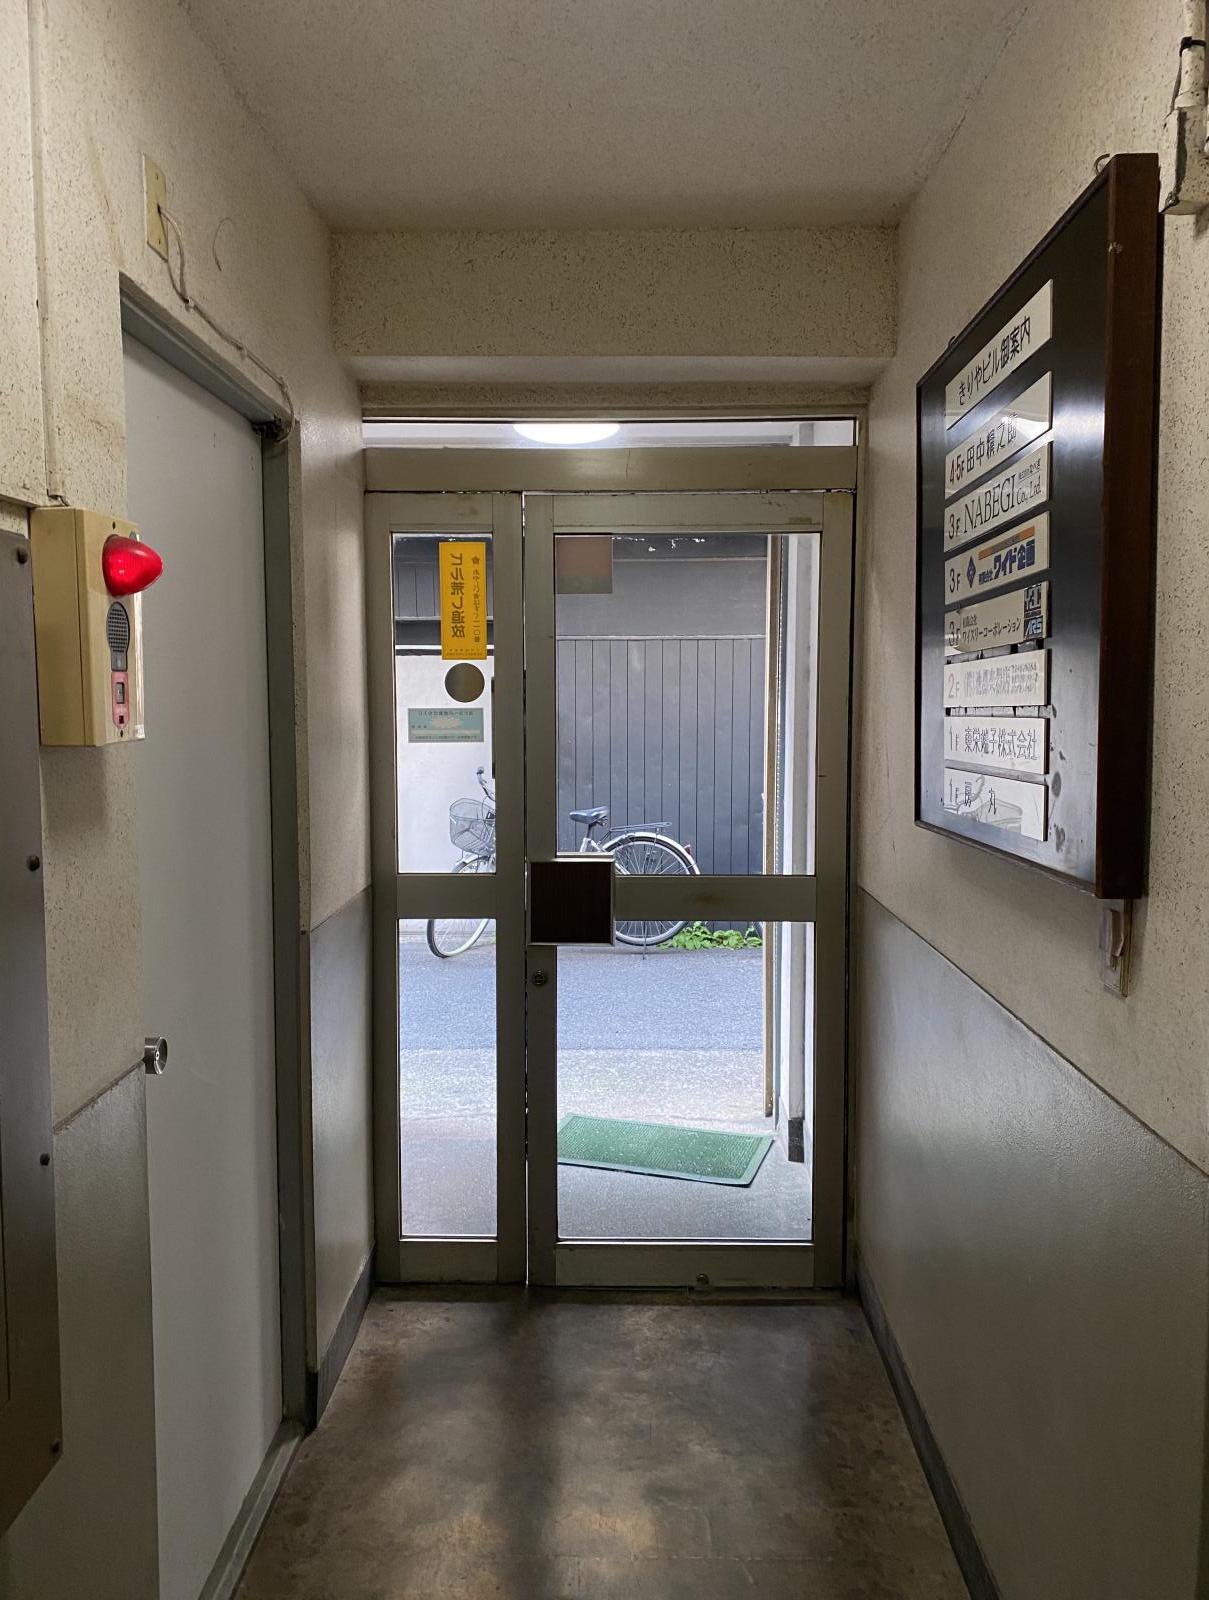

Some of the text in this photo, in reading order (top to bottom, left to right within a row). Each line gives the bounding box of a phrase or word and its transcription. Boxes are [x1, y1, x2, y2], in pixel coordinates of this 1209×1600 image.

[959, 315, 1031, 406] きりやビル御案内
[948, 513, 961, 540] 3F
[964, 474, 1017, 534] NABEGI
[949, 568, 961, 593] 3F
[962, 616, 1022, 644] ワイスリーコーポレーション
[948, 672, 960, 699] 2F
